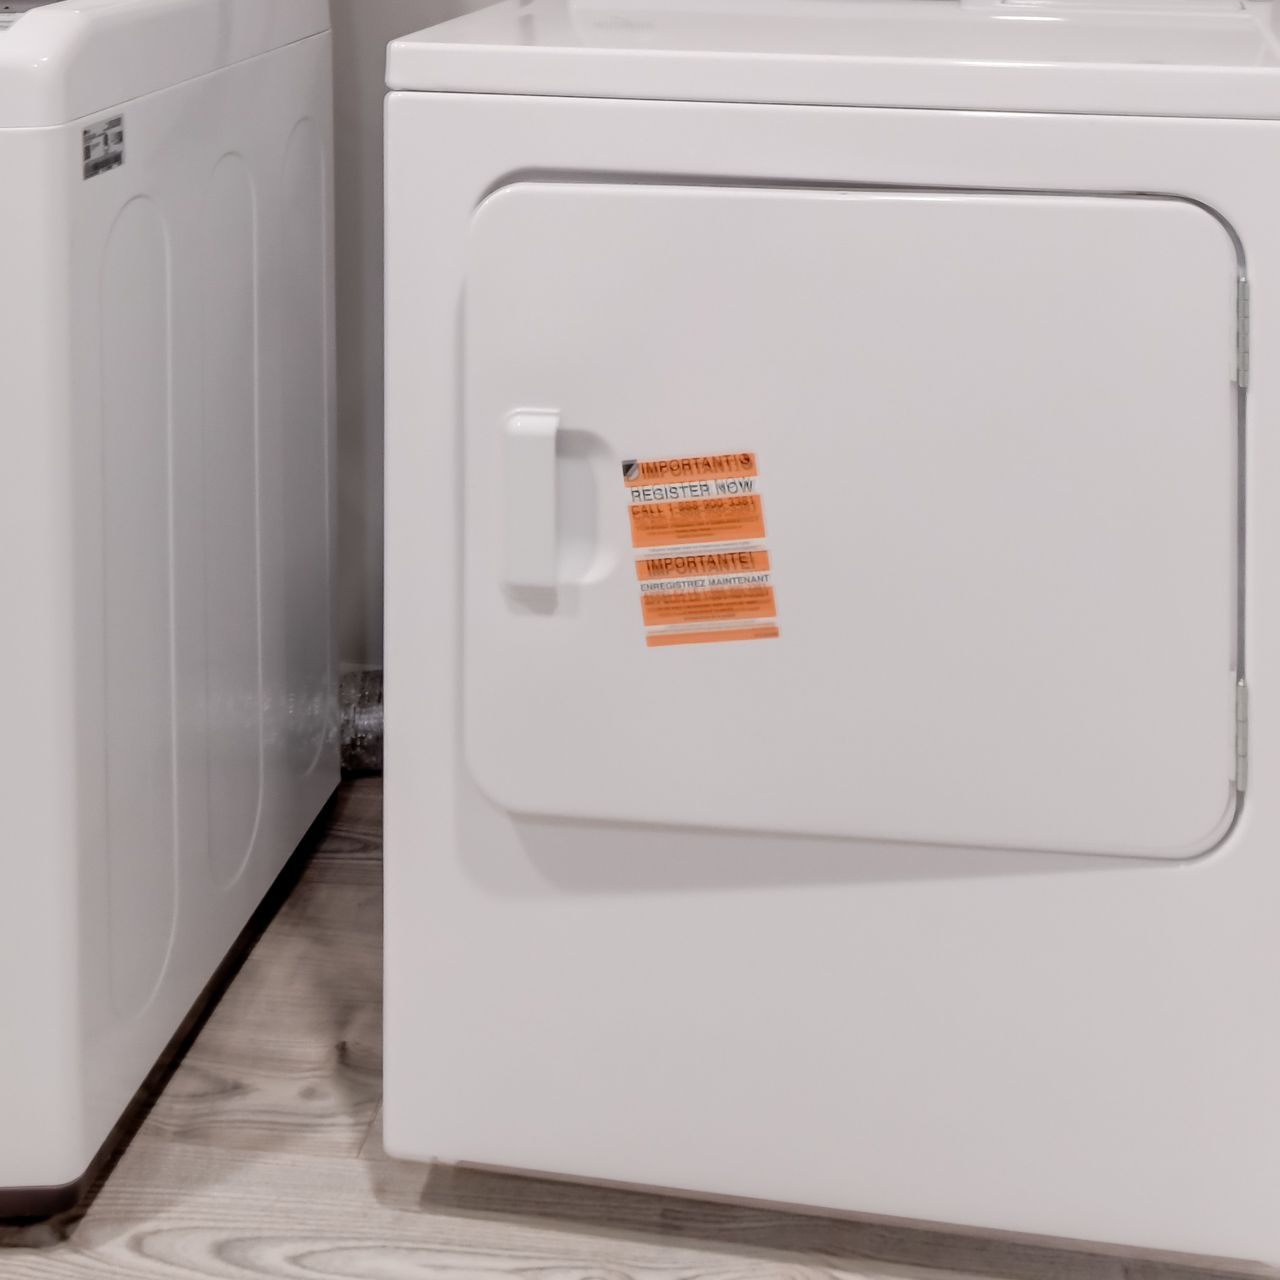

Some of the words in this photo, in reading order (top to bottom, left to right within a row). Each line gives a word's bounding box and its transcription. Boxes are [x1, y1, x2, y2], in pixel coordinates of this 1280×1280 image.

[630, 483, 711, 503] REGISTER
[715, 479, 754, 498] NOW
[640, 579, 706, 592] ENREGISTREZ
[708, 574, 770, 588] MAINTENANT
